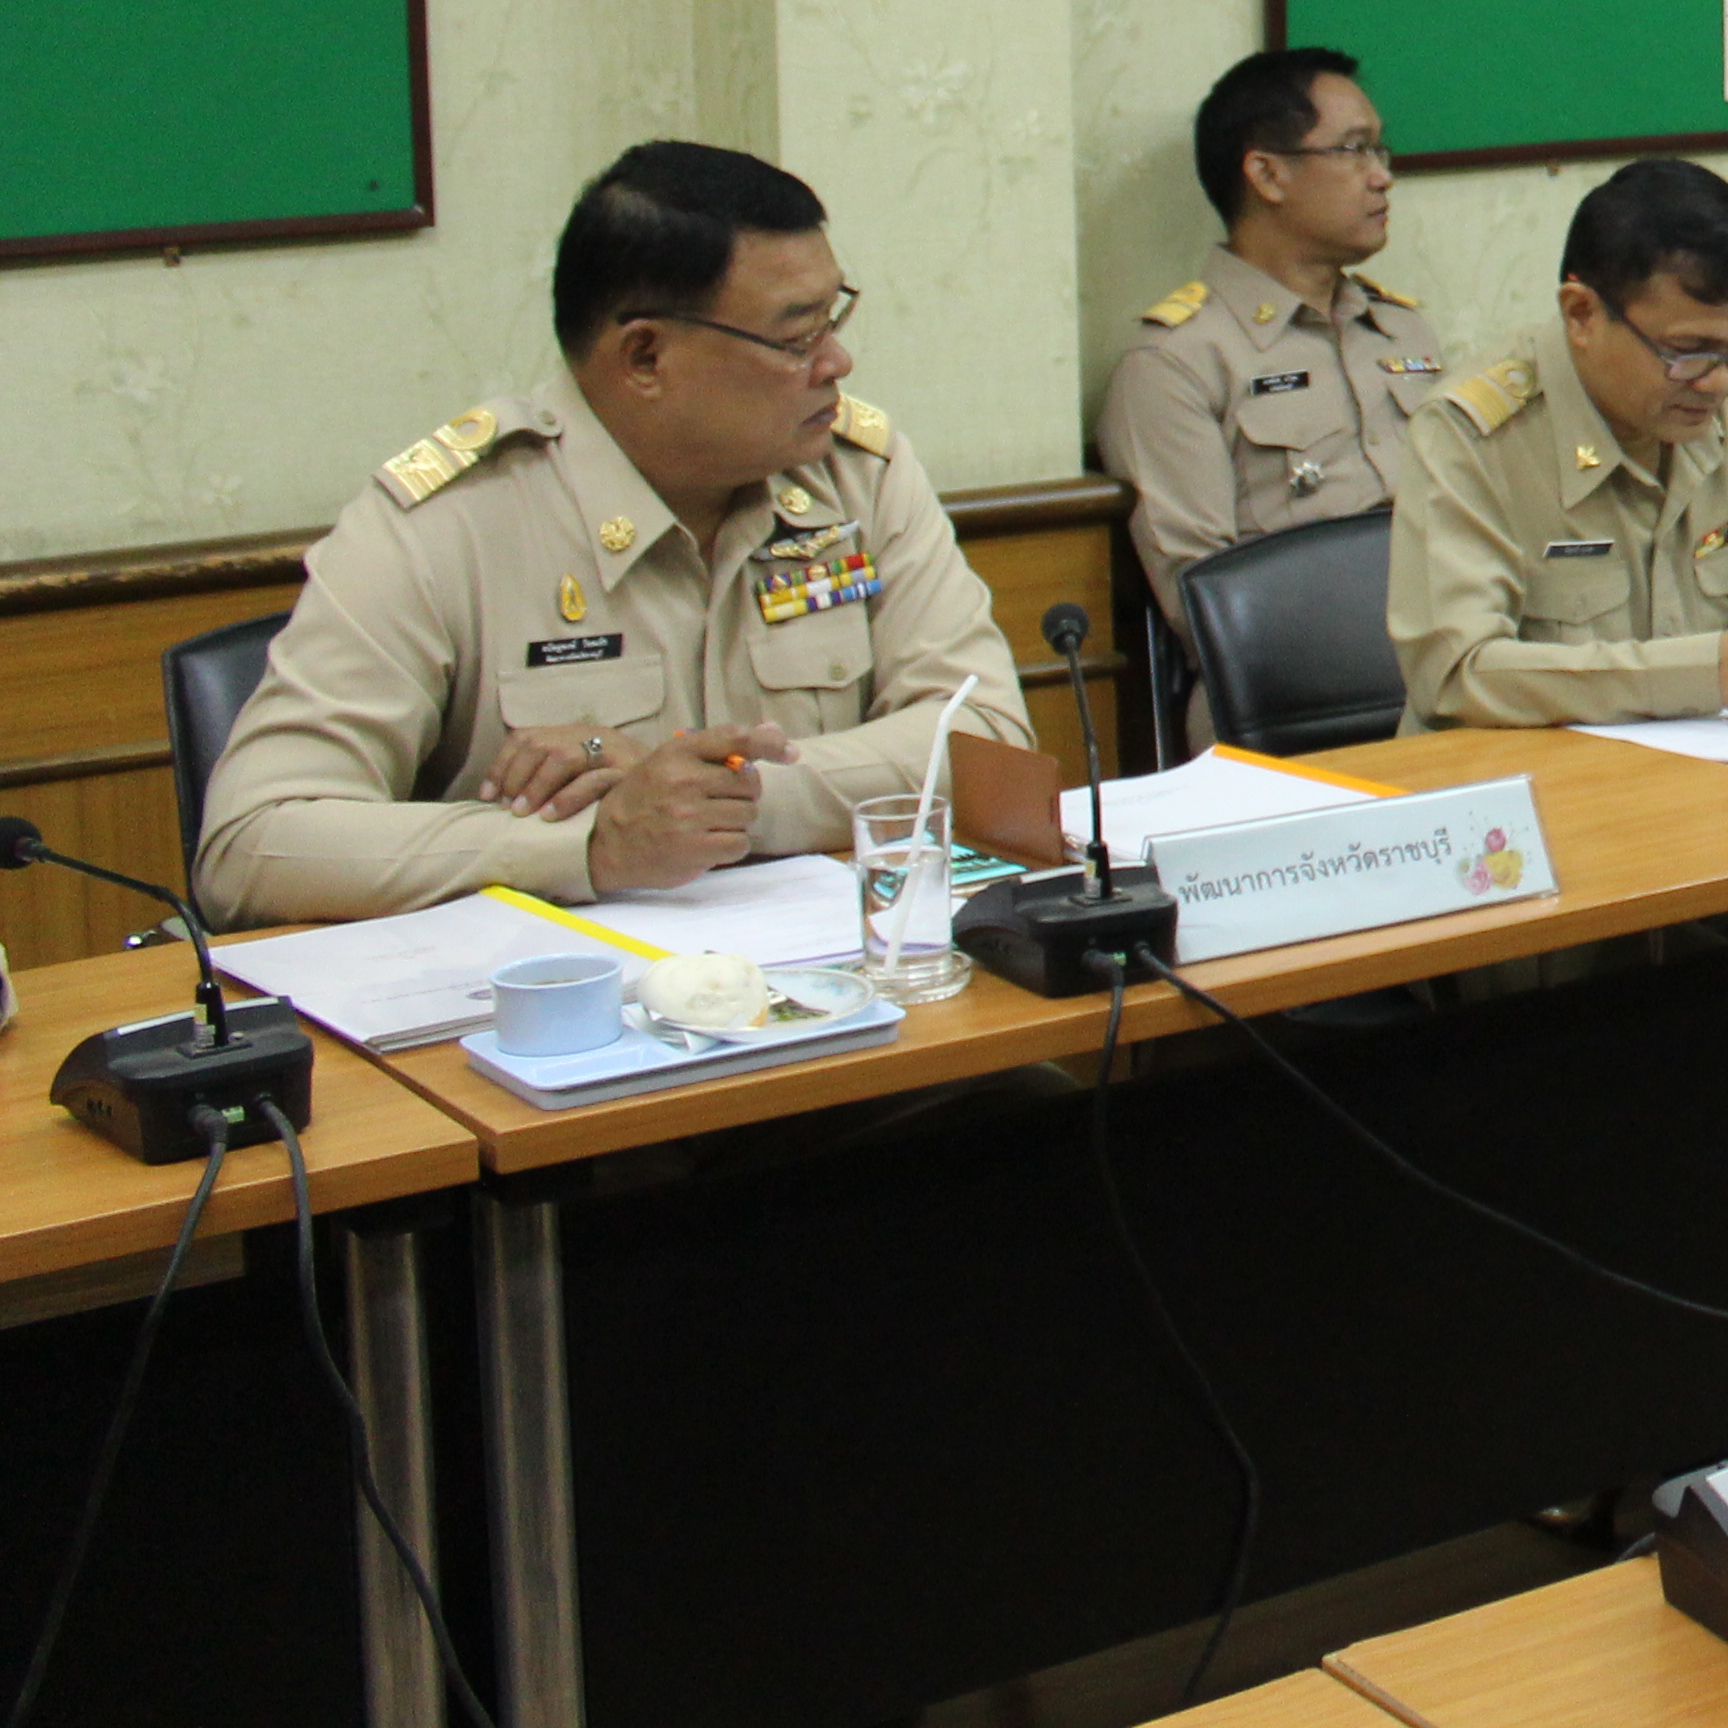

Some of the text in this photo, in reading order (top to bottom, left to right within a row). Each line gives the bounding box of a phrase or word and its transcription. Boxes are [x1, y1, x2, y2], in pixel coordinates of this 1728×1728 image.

[1178, 826, 1454, 905] พัฒนาการจังหวัดราชบุรี
